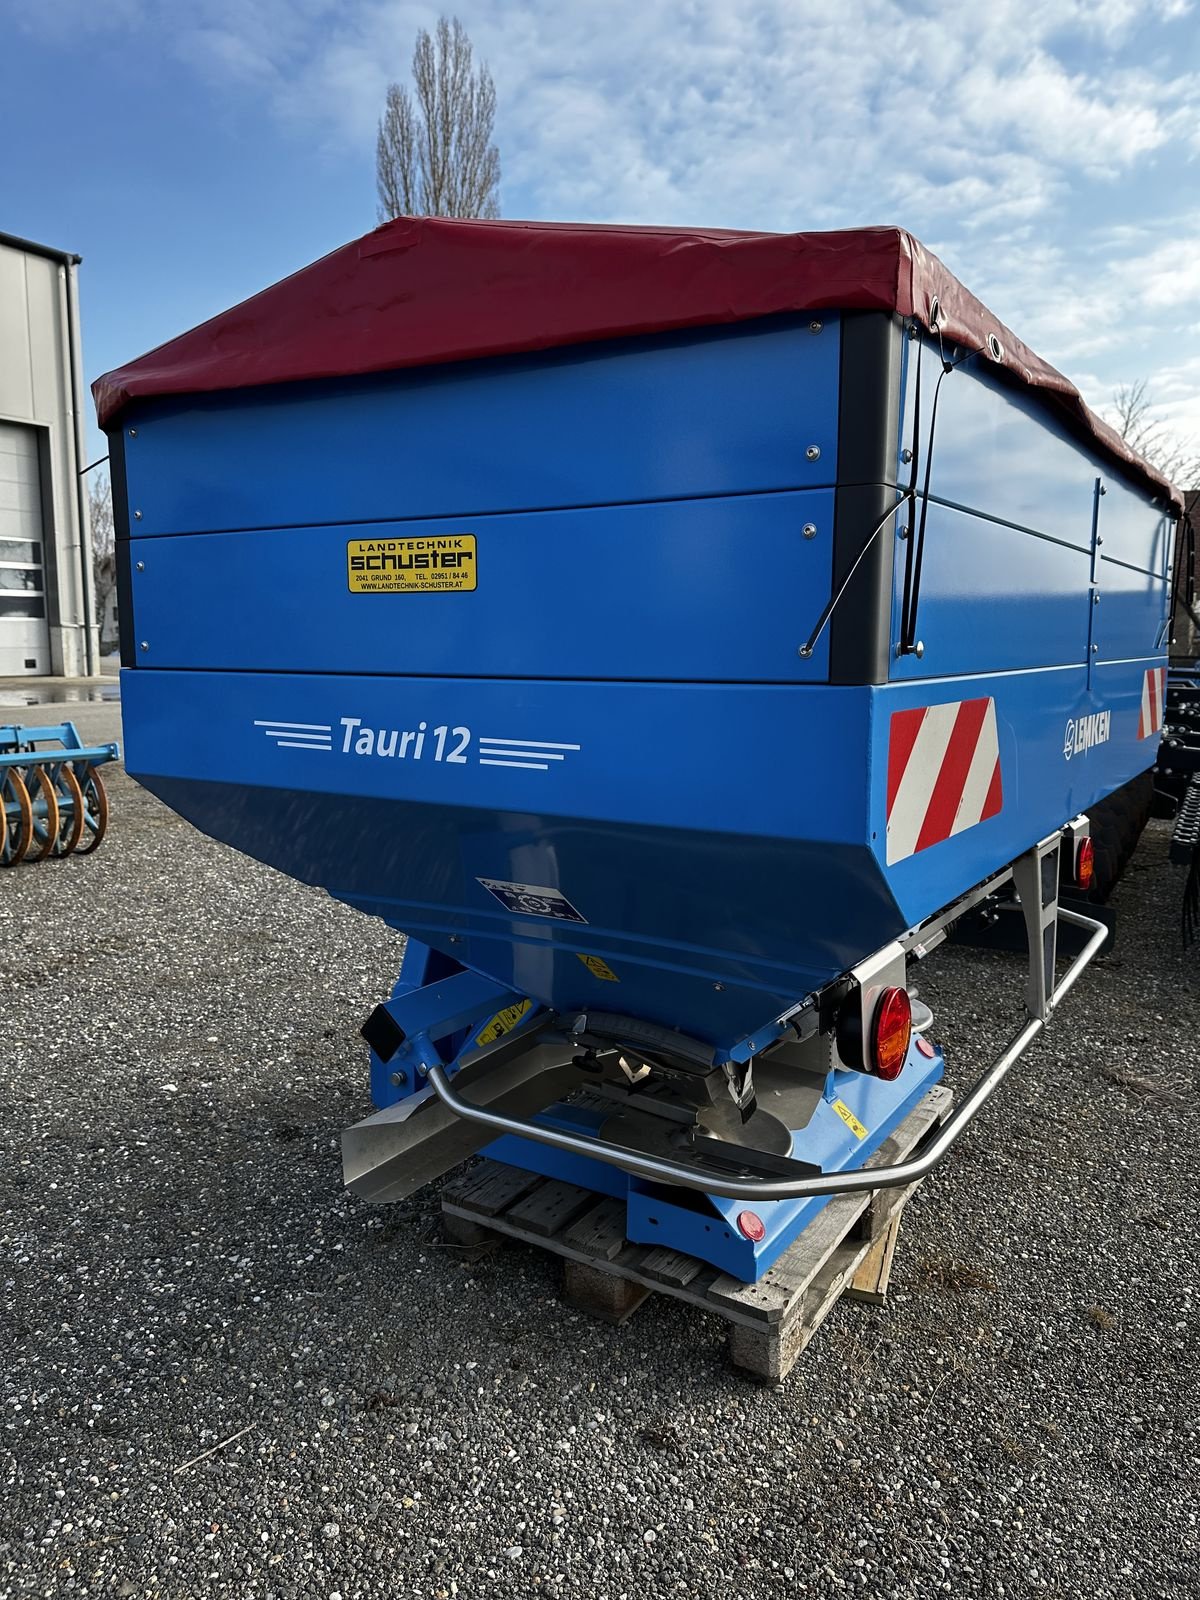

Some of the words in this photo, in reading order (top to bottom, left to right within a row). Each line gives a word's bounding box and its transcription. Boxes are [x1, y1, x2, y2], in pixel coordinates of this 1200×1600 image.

[359, 540, 463, 552] LANDTECHNIK
[351, 550, 472, 570] schuster
[356, 574, 368, 582] 2041
[394, 574, 407, 582] 160,
[431, 572, 448, 580] 02951
[361, 581, 463, 590] WWW.LANDTECHNIK-SCHUSTER.AT
[340, 717, 427, 760] Tauri
[433, 725, 471, 764] 12
[1074, 710, 1111, 756] LEMKEN
